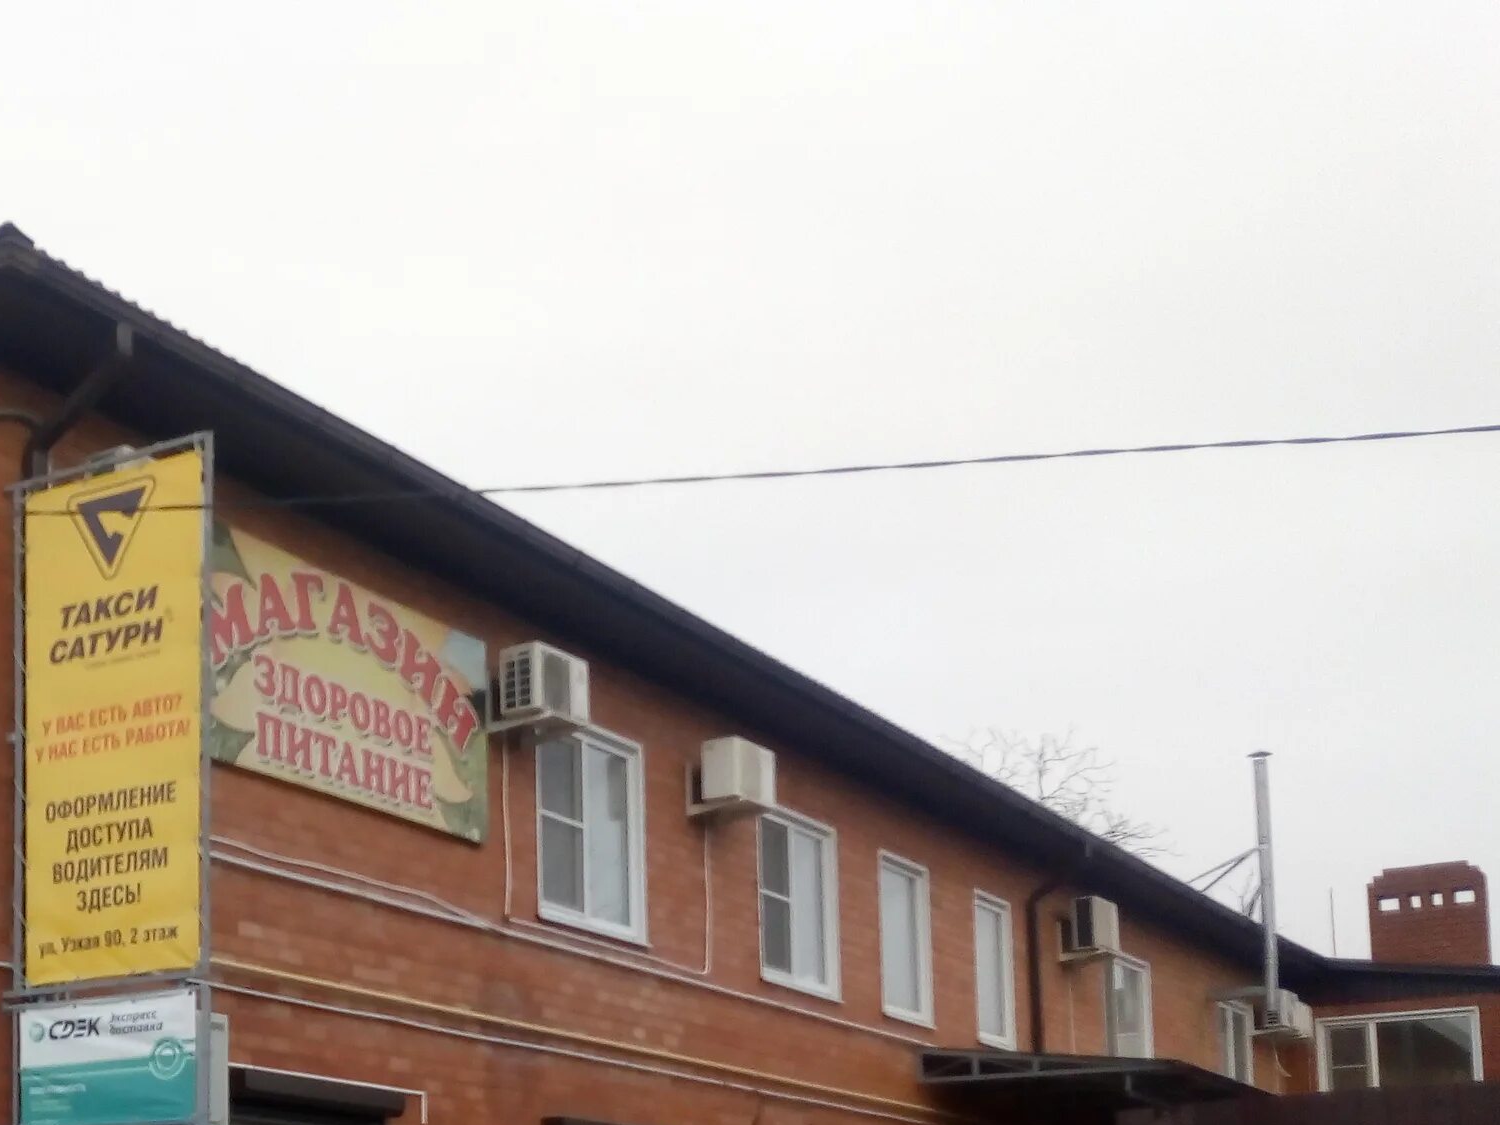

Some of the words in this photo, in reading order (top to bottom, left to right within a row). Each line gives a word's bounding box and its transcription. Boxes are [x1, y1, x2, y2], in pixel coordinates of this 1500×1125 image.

[61, 585, 158, 630] ТАКСИ
[50, 617, 163, 665] САТУРН
[211, 572, 481, 753] МАГАЗИН
[43, 721, 52, 736] У
[56, 712, 85, 734] ВАС
[89, 704, 127, 728] ЕСТЬ
[132, 693, 182, 719] АВТО?
[252, 654, 434, 757] ЗДОРОВОЕ
[36, 748, 44, 763] У
[49, 740, 77, 760] НАС
[82, 732, 121, 754] ЕСТЬ
[125, 719, 190, 747] РАБОТА!
[255, 711, 434, 812] ПИТАНИЕ
[45, 781, 176, 823] ОФОРМЛЕНИЕ
[66, 816, 153, 855] ДОСТУПА
[52, 846, 168, 884] ВОДИТЕЛЯМ
[76, 882, 141, 914] ЗДЕСЬ!
[61, 935, 99, 952] Узкая
[130, 927, 138, 944] 2
[143, 926, 179, 942] этаж
[49, 1016, 101, 1040] CDEK
